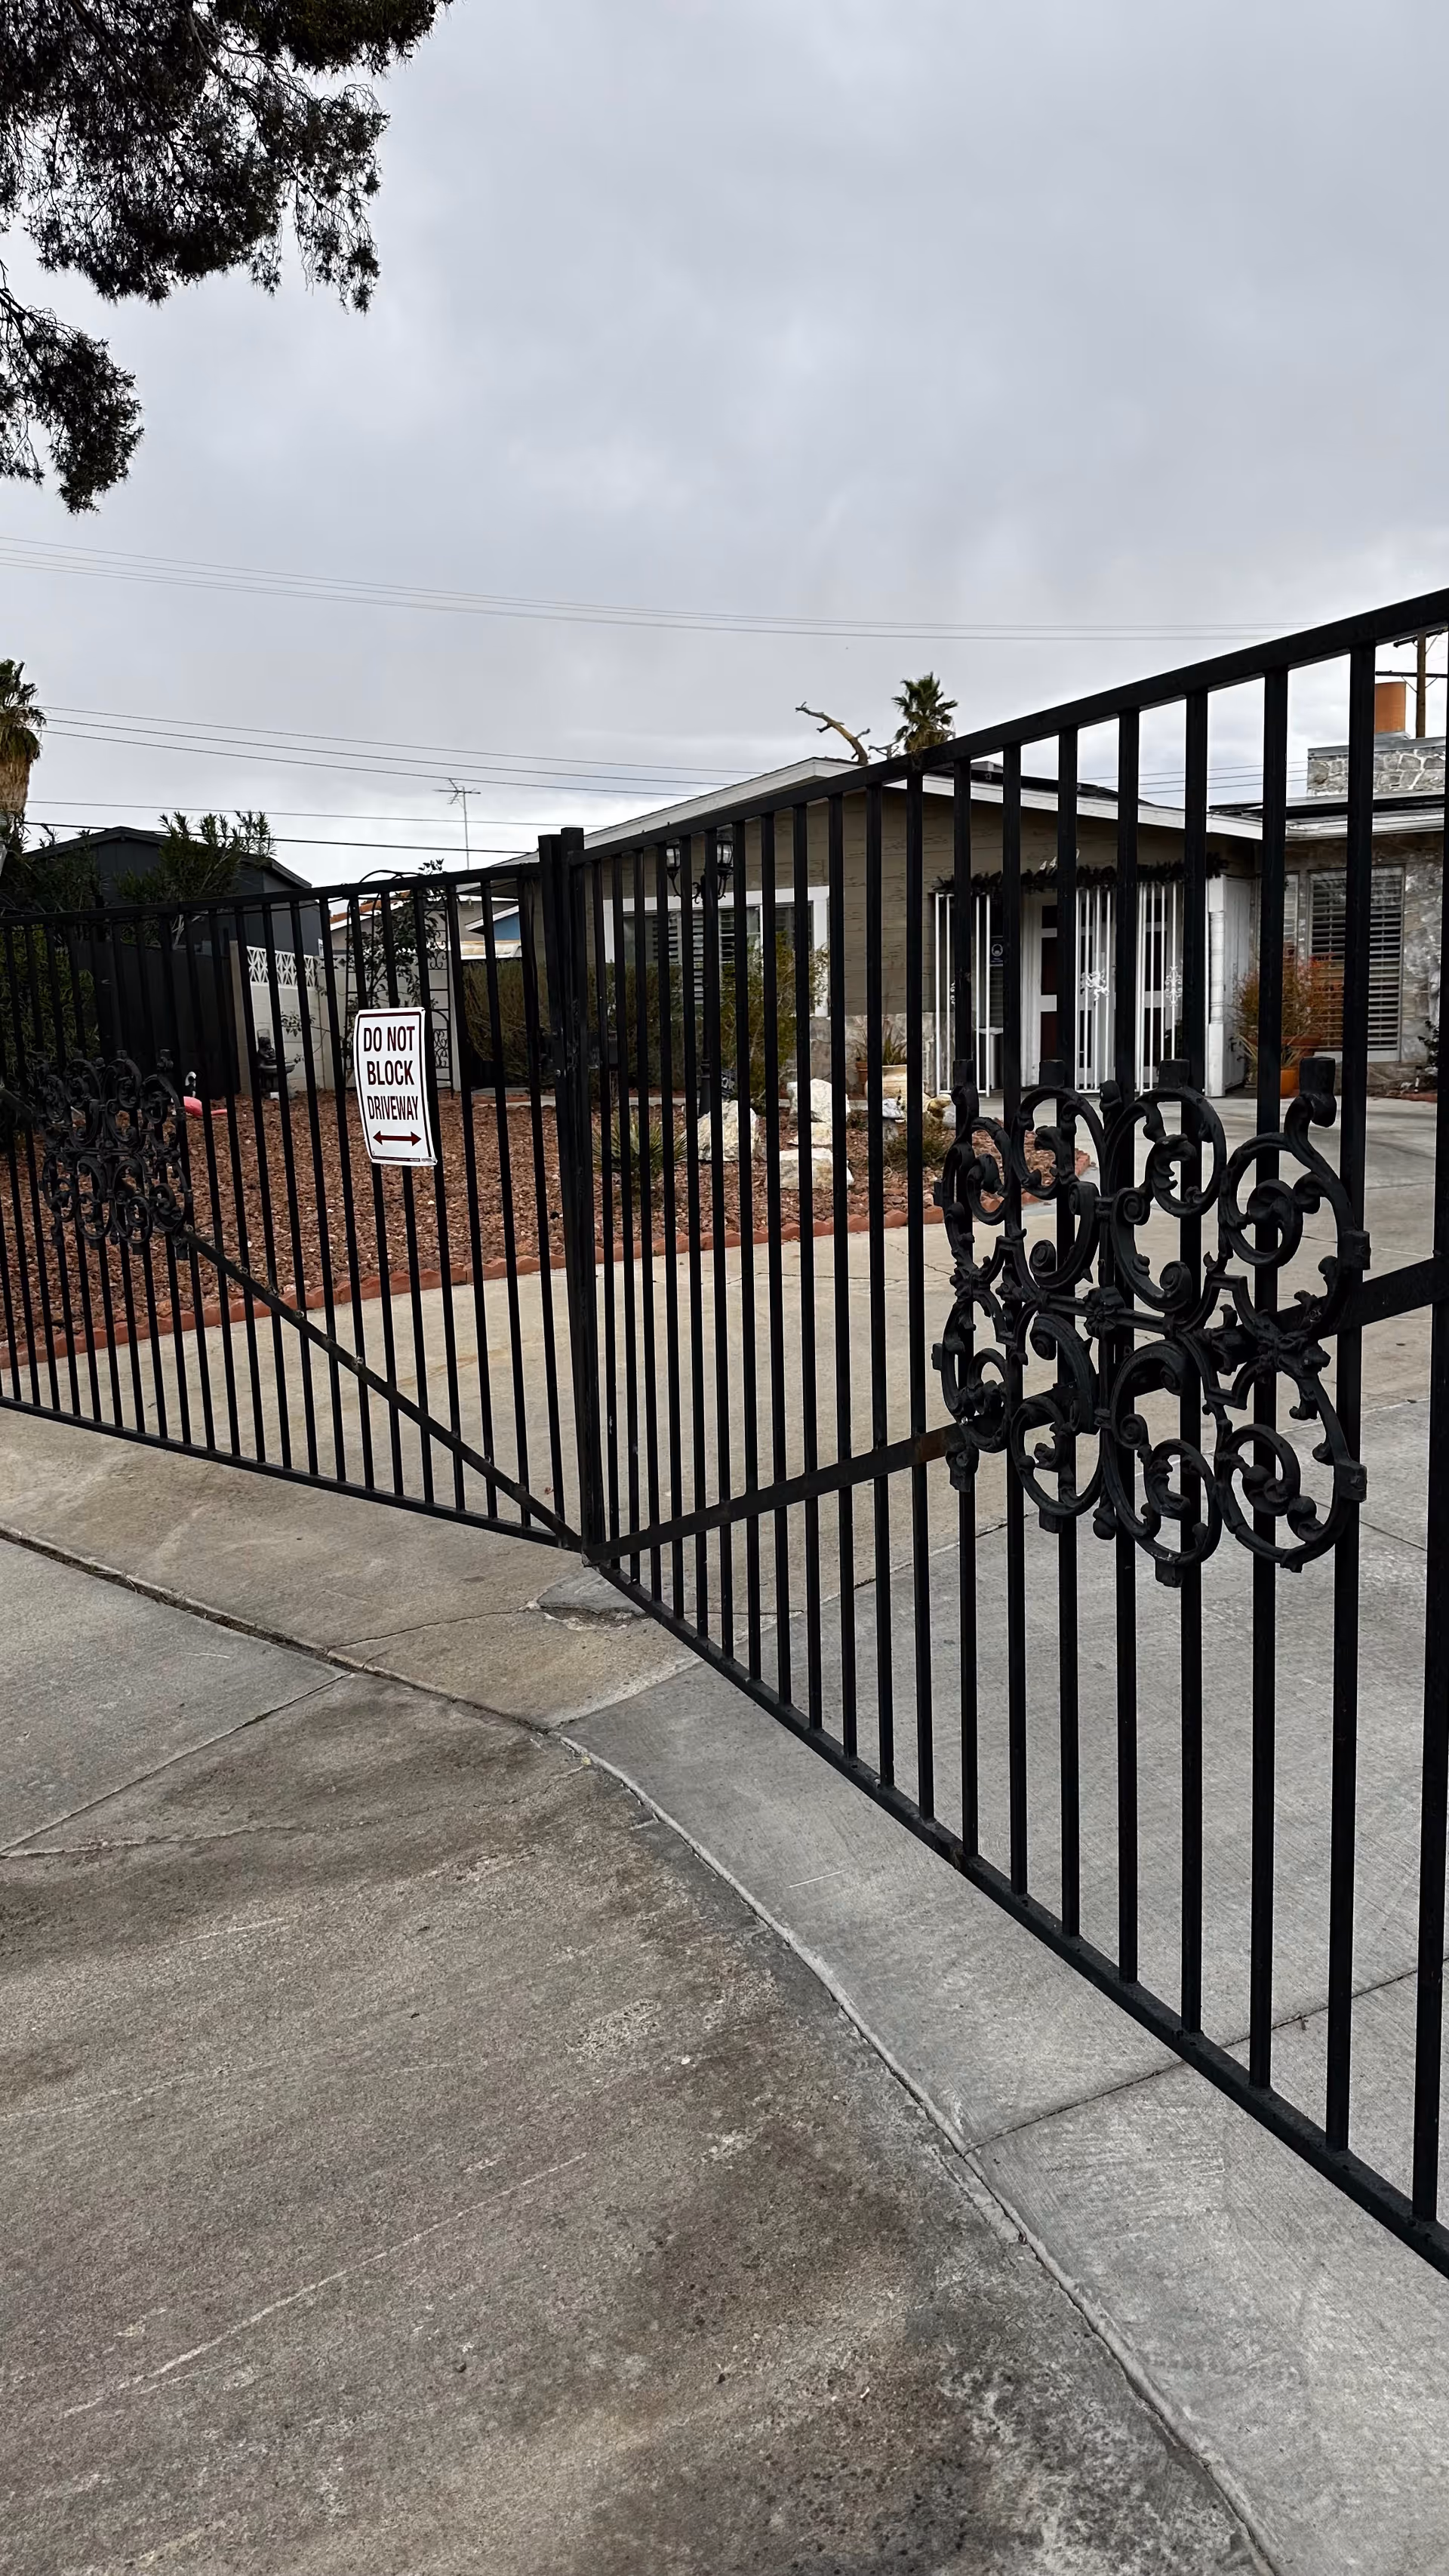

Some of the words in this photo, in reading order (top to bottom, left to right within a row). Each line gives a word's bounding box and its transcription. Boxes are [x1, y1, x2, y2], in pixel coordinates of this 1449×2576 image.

[364, 1027, 382, 1051] DO
[388, 1026, 415, 1051] NOT
[367, 1060, 414, 1085] BLOCK
[367, 1096, 418, 1120] DRIVEWAY
